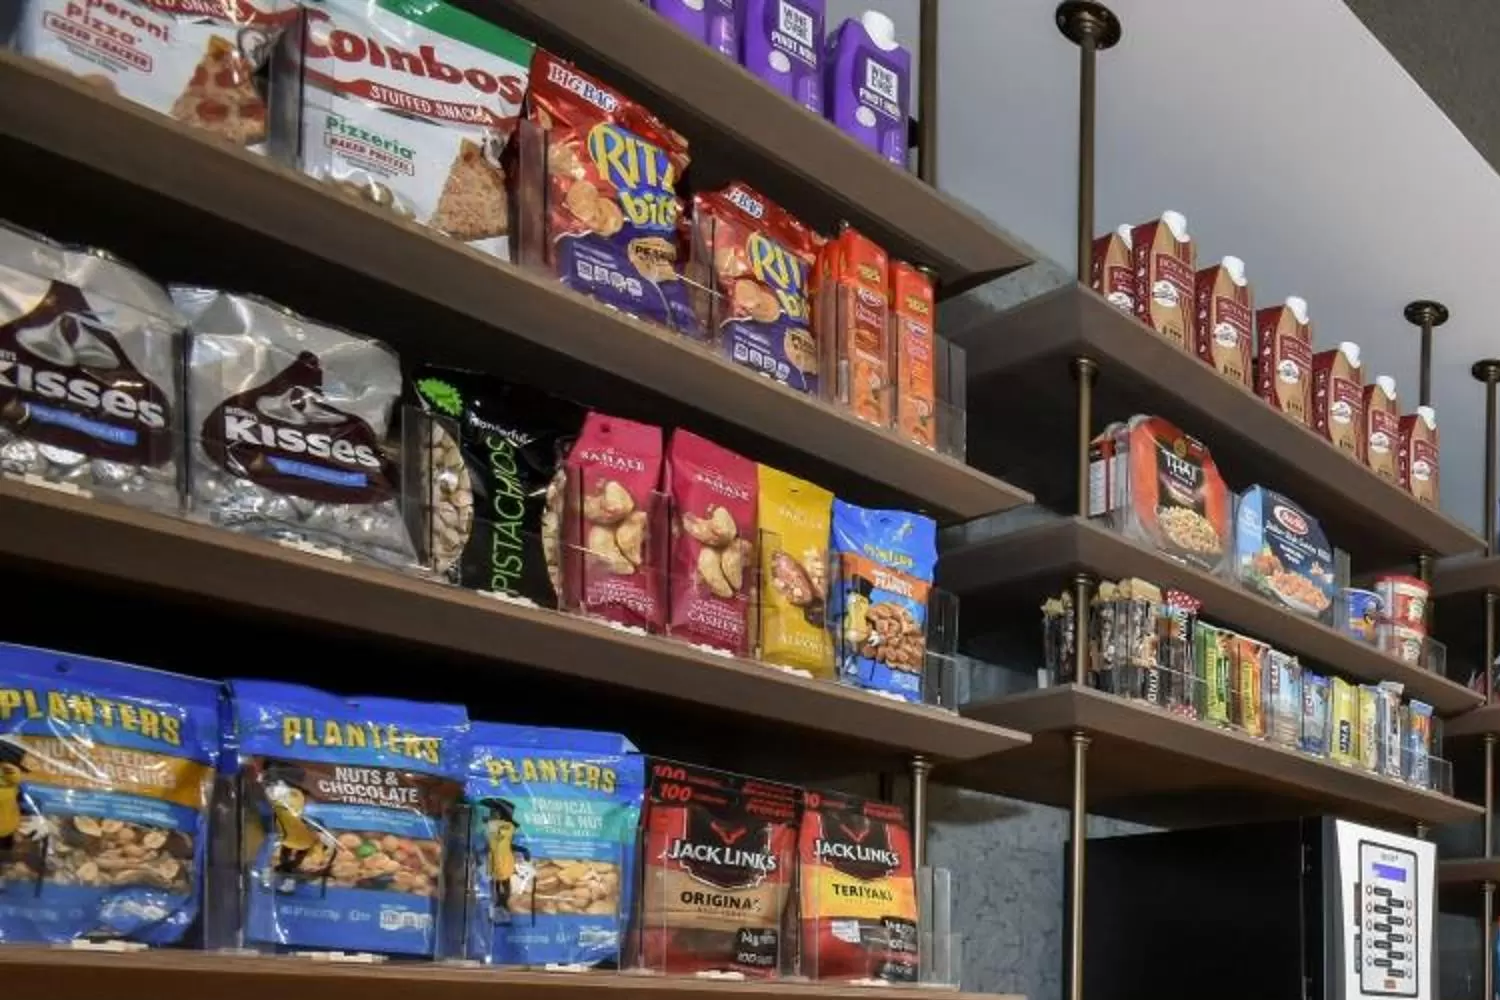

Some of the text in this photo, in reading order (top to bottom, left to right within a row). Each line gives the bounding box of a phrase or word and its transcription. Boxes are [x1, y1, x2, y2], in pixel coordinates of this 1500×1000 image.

[370, 84, 431, 114] STUFFED
[549, 62, 618, 112] BIG BAG
[750, 231, 809, 294] RIT
[486, 436, 525, 594] PISTACHIOS
[0, 688, 183, 746] PLANTERS
[282, 716, 442, 764] PLANTERS
[335, 766, 398, 786] NUTS &
[485, 756, 618, 793] PLANTERS
[319, 780, 419, 803] CHOCOLATE
[660, 784, 692, 801] 100
[667, 839, 722, 865] JACK
[813, 838, 856, 861] JACK
[831, 883, 894, 903] TERIYAKI
